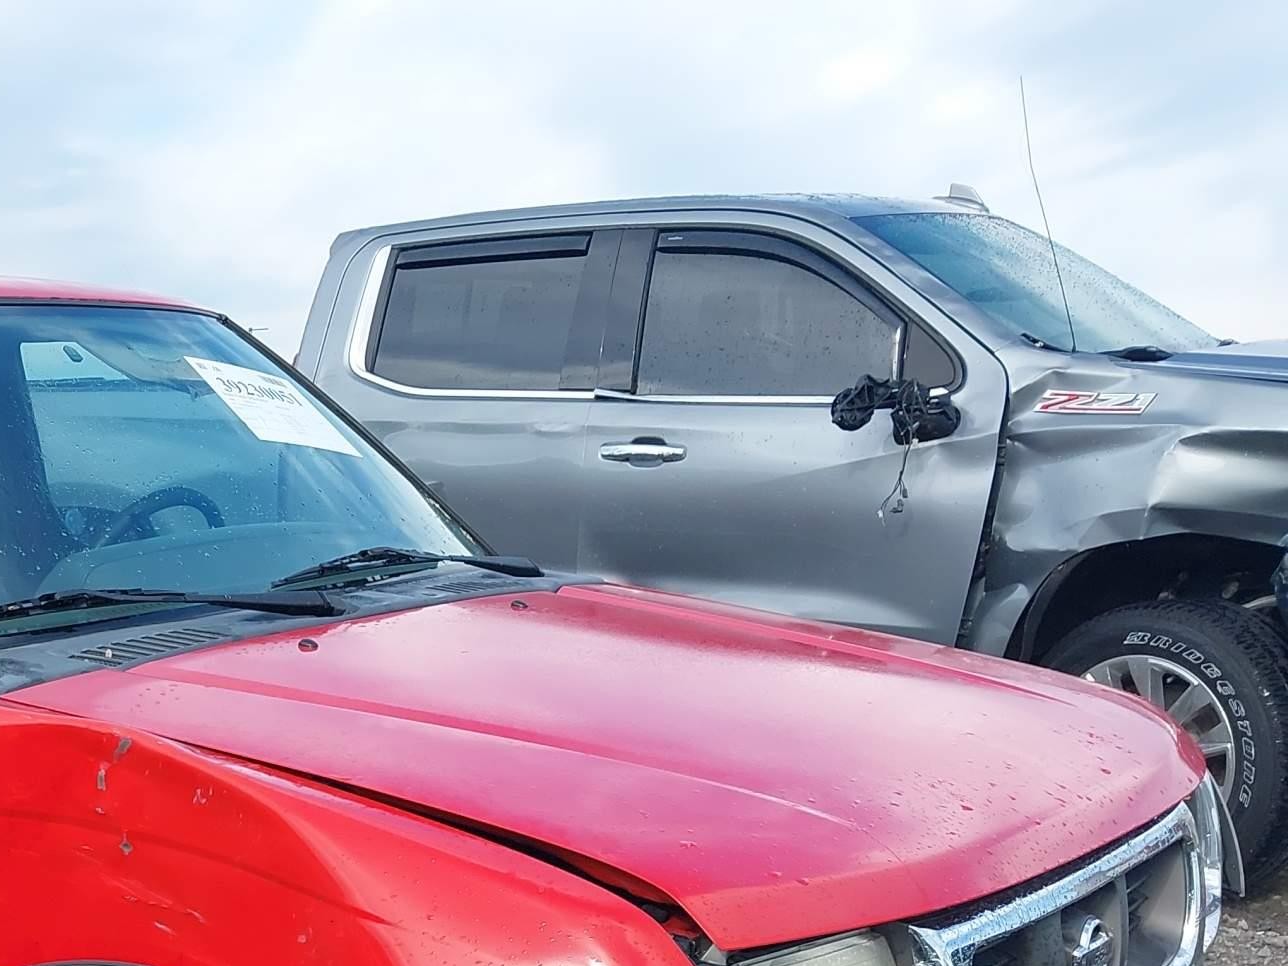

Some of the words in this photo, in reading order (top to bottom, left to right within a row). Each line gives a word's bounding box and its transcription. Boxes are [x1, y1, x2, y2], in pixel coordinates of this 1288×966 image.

[215, 376, 303, 407] 39230051
[1032, 389, 1158, 415] Z71
[1123, 631, 1256, 808] BRIDGESTONE
